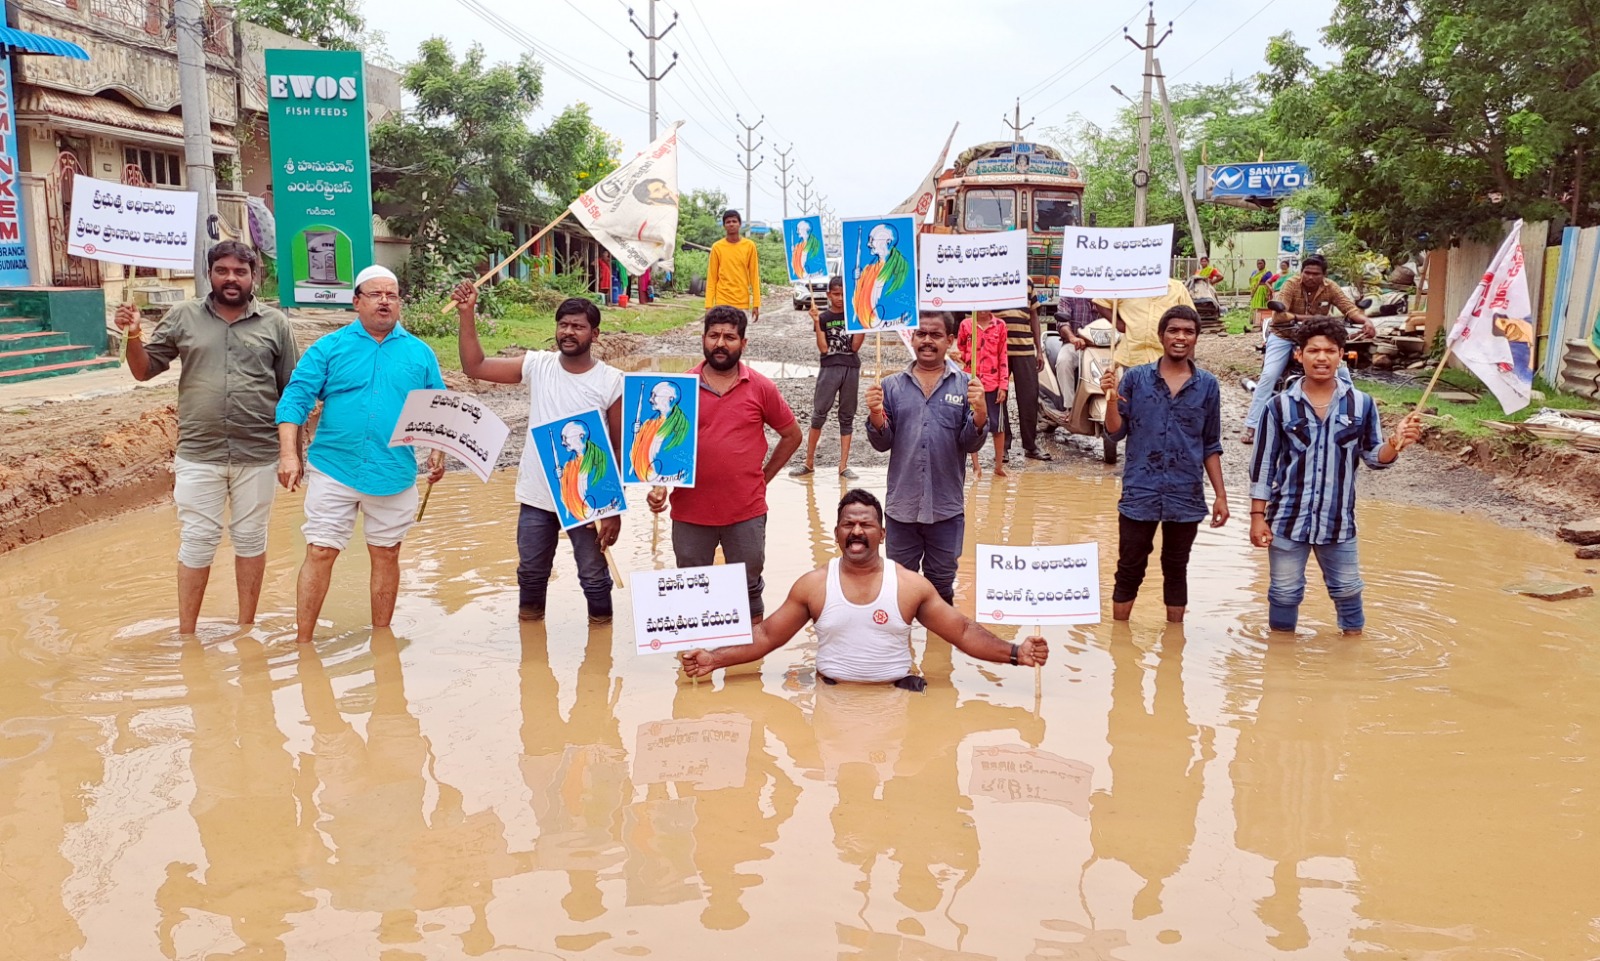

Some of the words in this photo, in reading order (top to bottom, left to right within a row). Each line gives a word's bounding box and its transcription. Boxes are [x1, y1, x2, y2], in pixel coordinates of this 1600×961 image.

[270, 75, 357, 100] EWOS
[285, 106, 311, 116] FISH
[314, 107, 349, 117] FEEDS
[283, 157, 296, 175] శ్రీ
[297, 159, 355, 173] హనుమాన్
[1248, 166, 1293, 175] SAHARA
[92, 190, 124, 214] ప్రభుత్వ
[126, 199, 176, 215] అధికారులు
[306, 206, 336, 216] గుడివాడ
[75, 217, 101, 238] ప్రజల
[102, 225, 141, 242] ప్రాణాలు
[143, 231, 188, 246] కాపాడండి
[1076, 235, 1109, 250] R&b
[1113, 237, 1163, 251] అధికారులు
[936, 244, 963, 263] ప్రభుత్వ
[964, 244, 1008, 261] అధికారులు
[925, 273, 945, 293] ప్రజల
[947, 275, 980, 293] ప్రాణాలు
[982, 270, 1021, 287] కాపాడండి
[1070, 265, 1104, 277] వెంటనే
[1105, 264, 1162, 281] స్పందించండి
[314, 292, 338, 300] Cargill
[430, 394, 461, 409] బైపాస్
[461, 402, 483, 424] రోడ్డు
[459, 432, 489, 462] చేయండి
[990, 554, 1026, 570] R&b
[1031, 557, 1088, 572] అధికారులు
[658, 573, 685, 596] బైపాస్
[686, 573, 710, 594] రోడ్డు
[986, 588, 1023, 602] వెంటనే
[1025, 586, 1091, 606] స్పందించండి
[701, 608, 740, 627] చేయండి
